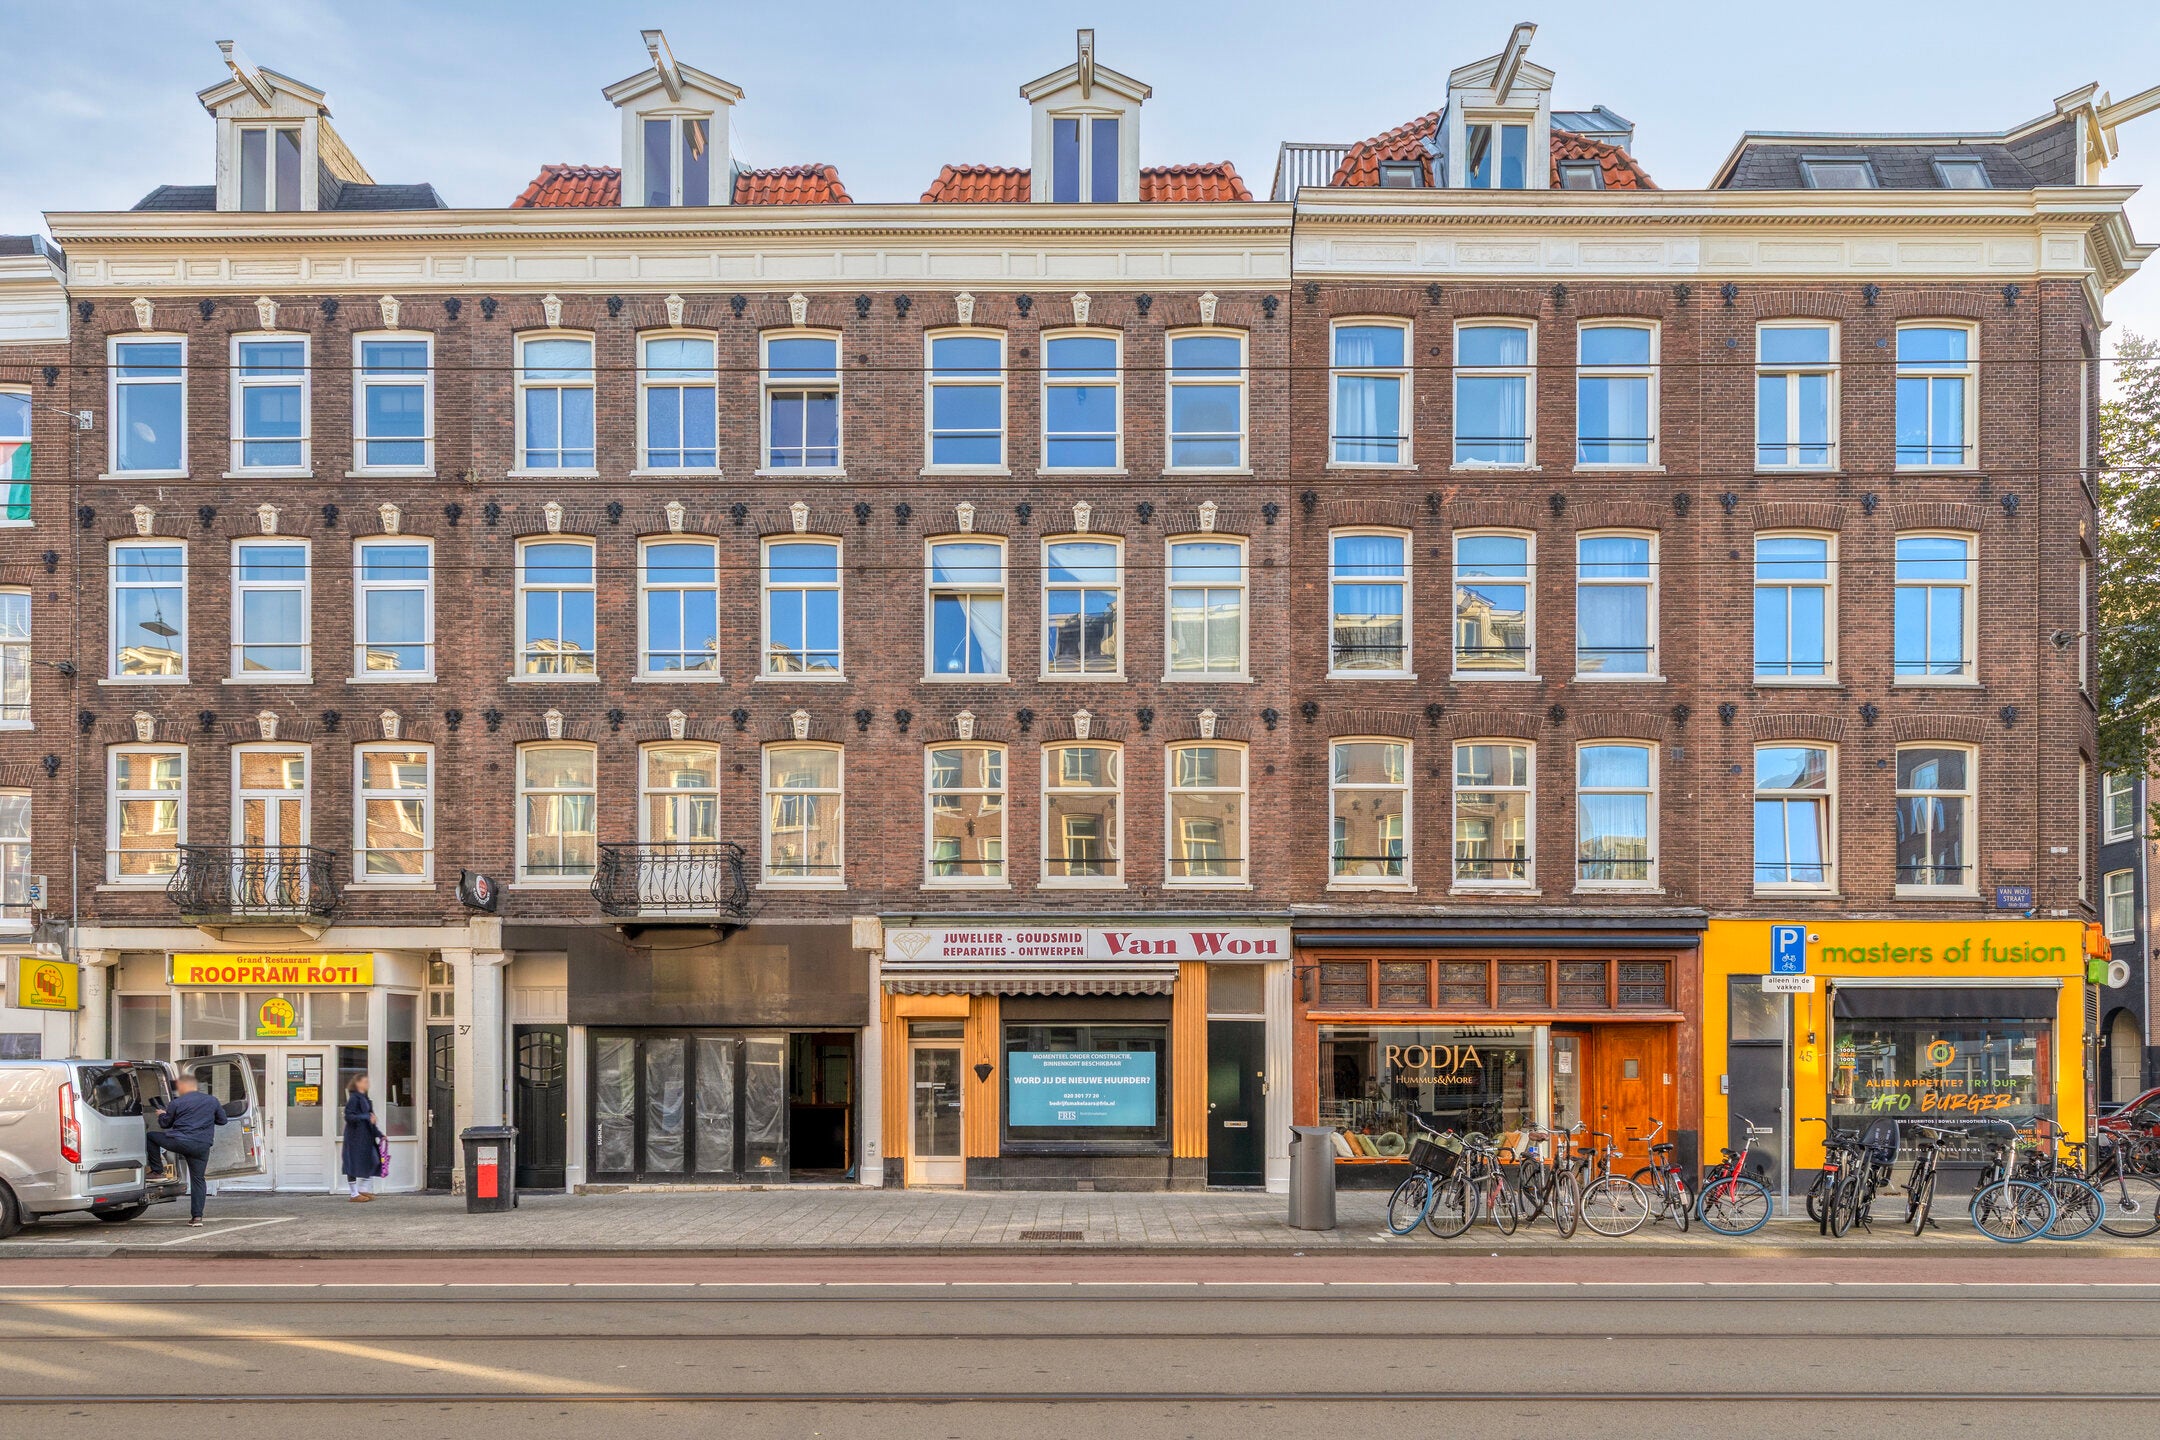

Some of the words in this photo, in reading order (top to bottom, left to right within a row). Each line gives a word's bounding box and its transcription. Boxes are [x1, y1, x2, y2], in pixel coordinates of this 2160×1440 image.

[944, 933, 1003, 944] JUWELIER
[1016, 932, 1082, 944] GOUDSMID
[1102, 932, 1178, 956] Van
[1189, 932, 1279, 956] Wou
[1780, 929, 1798, 953] P
[944, 947, 1006, 956] REPARATIES
[1019, 946, 1084, 956] ONTWERPEN
[1822, 942, 1933, 963] masters
[1944, 938, 1972, 963] of
[1982, 938, 2066, 963] fusion
[190, 966, 299, 983] ROOPRAM
[308, 966, 358, 983] ROTI
[458, 1025, 470, 1035] 37
[1385, 1044, 1482, 1074] RODJA
[1799, 1050, 1812, 1062] 45
[1871, 1093, 1911, 1112] UFO
[1921, 1094, 2012, 1115] BURGER
[1058, 1111, 1076, 1120] FRIS
